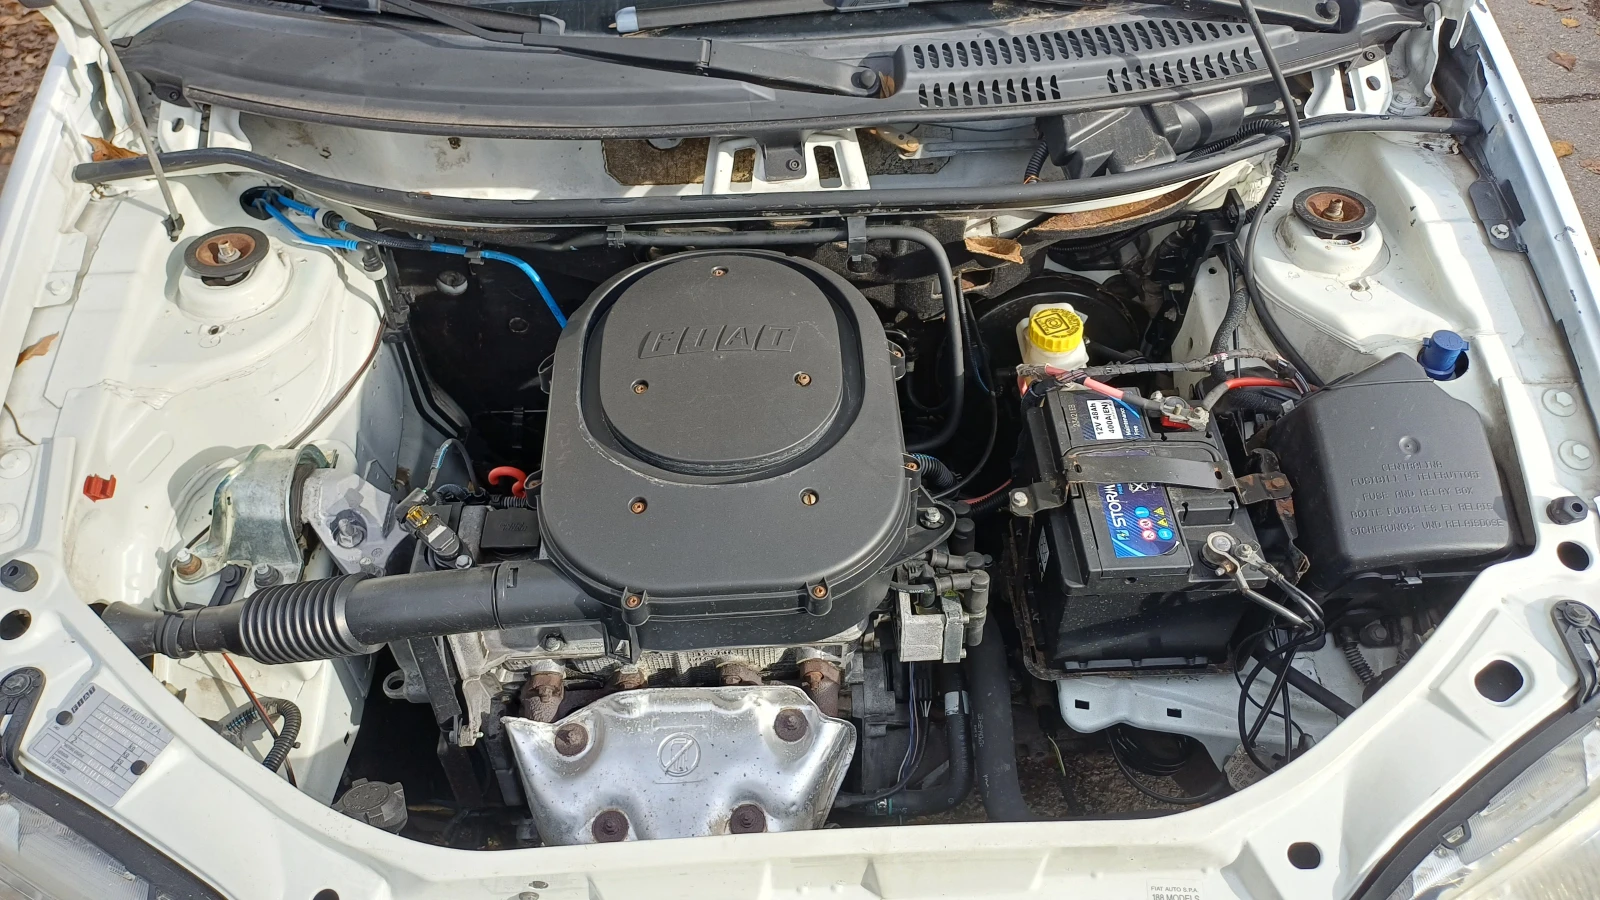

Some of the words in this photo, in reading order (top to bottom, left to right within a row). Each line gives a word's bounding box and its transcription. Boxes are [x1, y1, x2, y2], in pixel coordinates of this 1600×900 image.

[645, 326, 796, 354] FIAT
[1090, 402, 1099, 420] 48Ah
[1120, 407, 1132, 436] Maintenance
[1095, 422, 1103, 435] 12V
[1382, 461, 1442, 471] CENTRALINA
[1351, 476, 1400, 486] FUSIBILI
[1418, 471, 1480, 480] TELERUTTORI
[1362, 492, 1388, 501] FUSE
[1395, 490, 1415, 499] AND
[1420, 488, 1451, 496] RELAY
[1455, 487, 1474, 495] BOX
[1441, 504, 1452, 512] ET
[1459, 503, 1493, 512] RELAIS
[1422, 521, 1442, 530] UND
[1445, 519, 1504, 528] RELAISDOSE
[71, 686, 96, 714] FIAT
[120, 704, 134, 716] FIAT
[131, 712, 149, 726] AUTO
[129, 744, 137, 753] kg
[123, 751, 131, 760] kg
[110, 764, 119, 773] kg
[117, 758, 125, 767] kg
